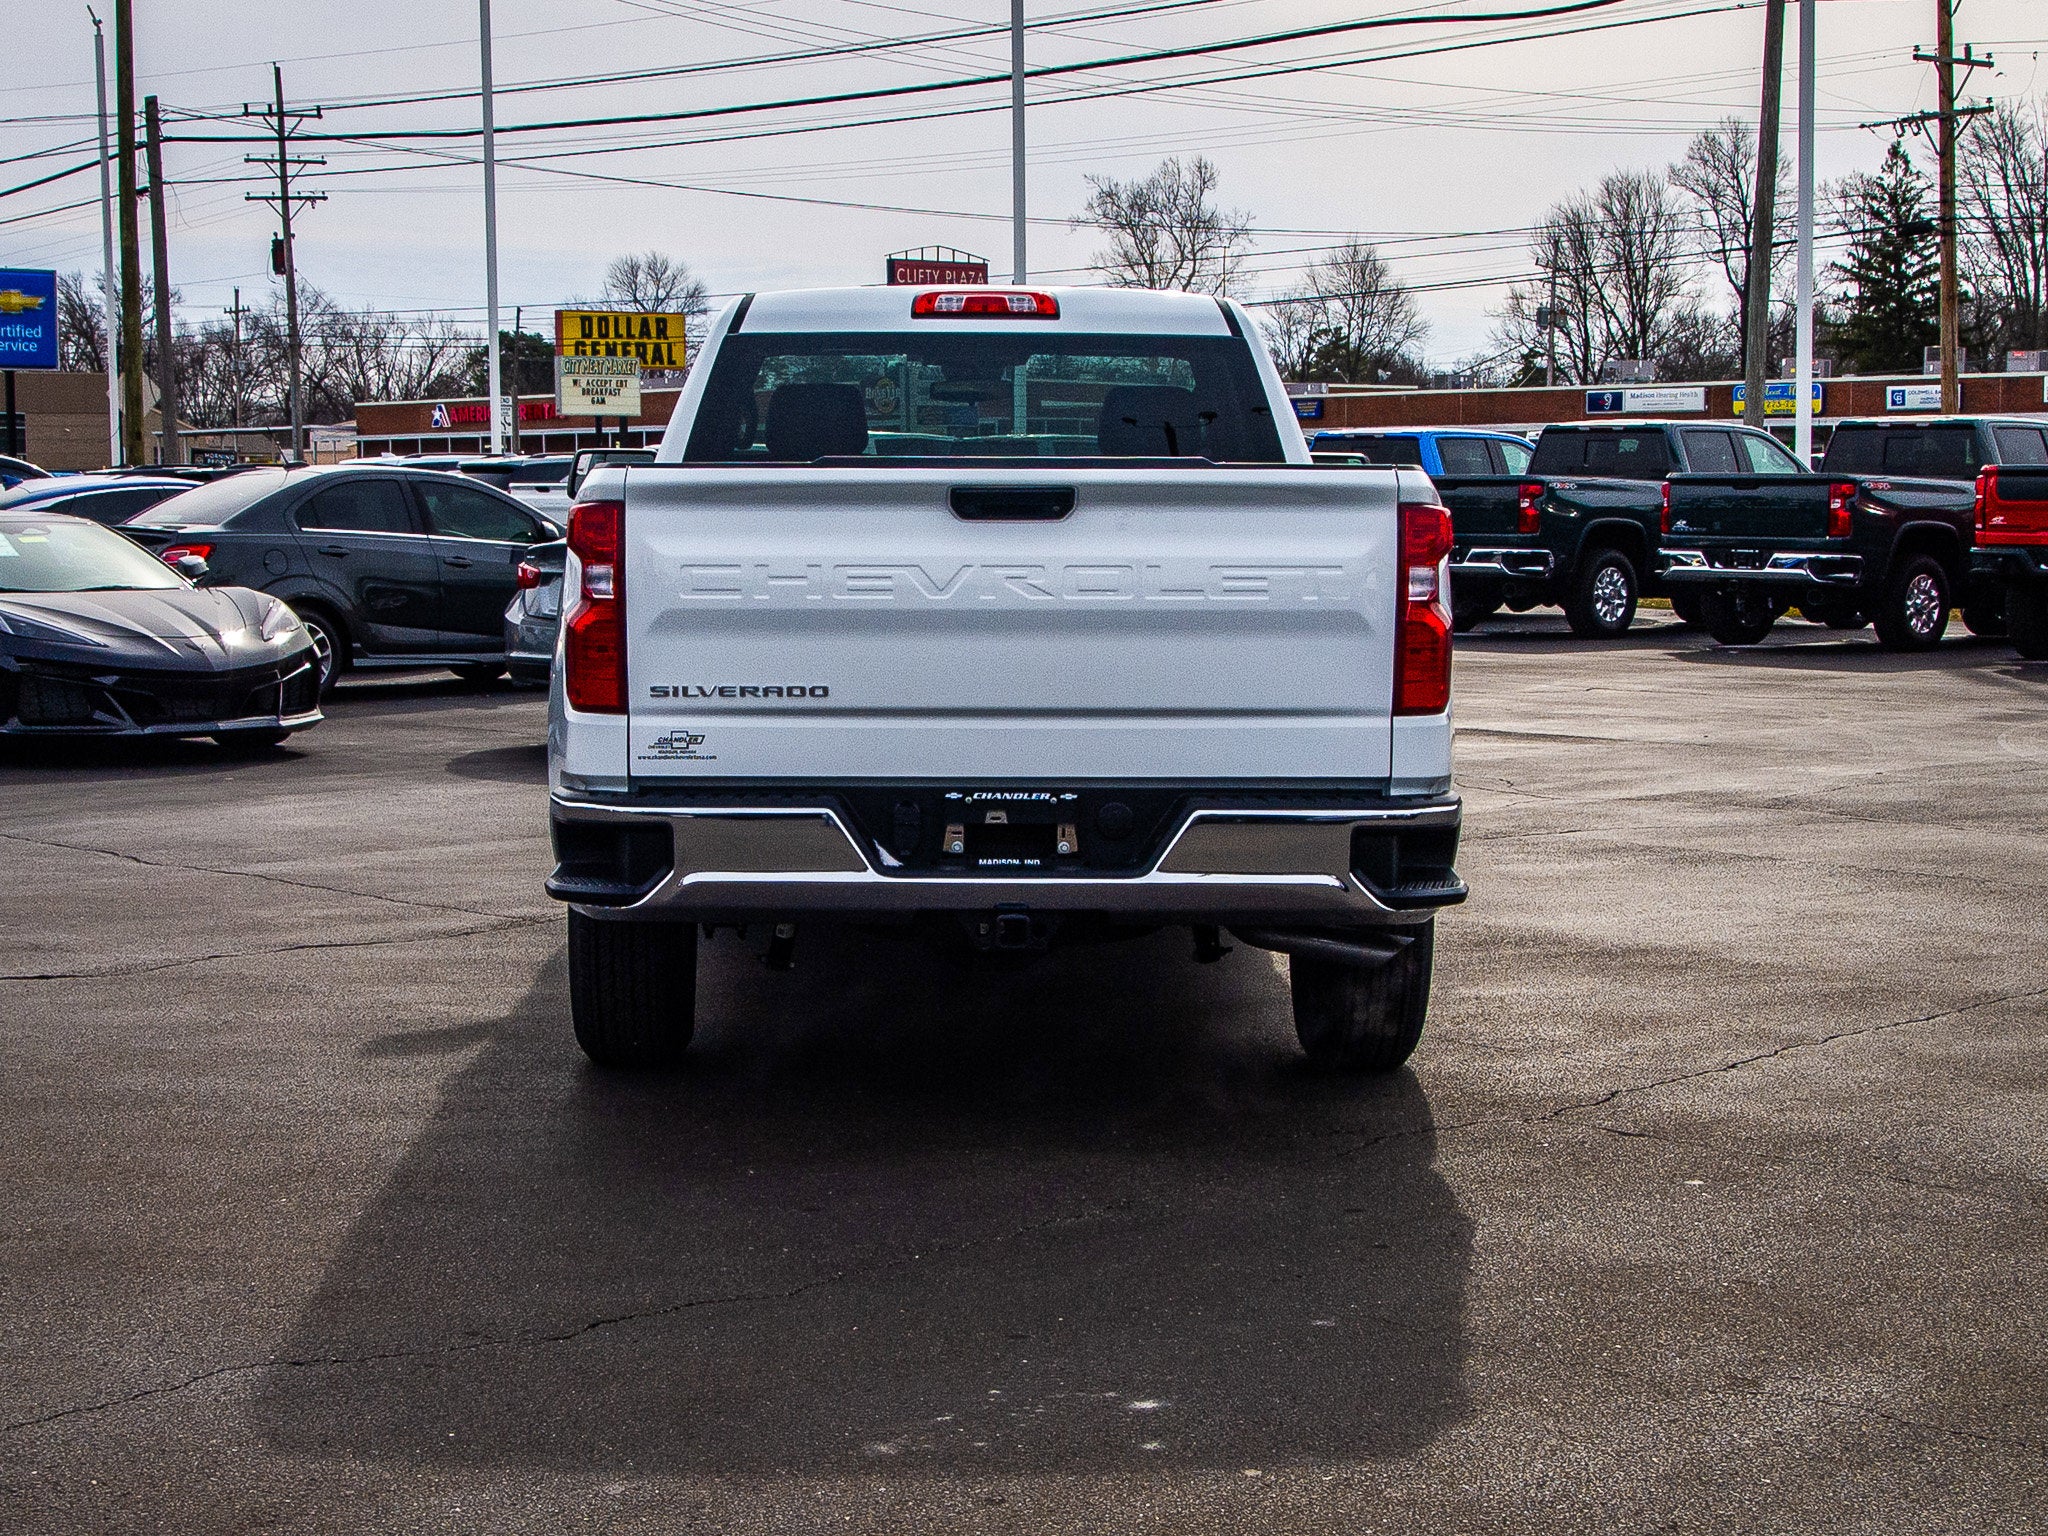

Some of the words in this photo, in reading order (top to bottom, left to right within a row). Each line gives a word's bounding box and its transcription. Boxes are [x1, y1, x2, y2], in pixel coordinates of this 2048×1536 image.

[897, 268, 940, 283] CLIFTY
[945, 271, 984, 284] PLAZA
[0, 325, 42, 338] rtified
[580, 315, 669, 340] DOLLAR
[0, 340, 37, 352] ervice
[574, 340, 677, 366] GENERAL
[564, 359, 581, 375] CITY
[581, 359, 604, 375] MEAT
[605, 360, 638, 375] MARKET
[572, 379, 582, 387] WE
[586, 379, 612, 387] ACCEPT
[615, 379, 628, 388] EBT
[581, 388, 621, 396] BREAKFAST
[450, 405, 491, 423] AMERI
[679, 564, 1349, 600] CHEVROLET
[650, 686, 829, 698] SILVERADO
